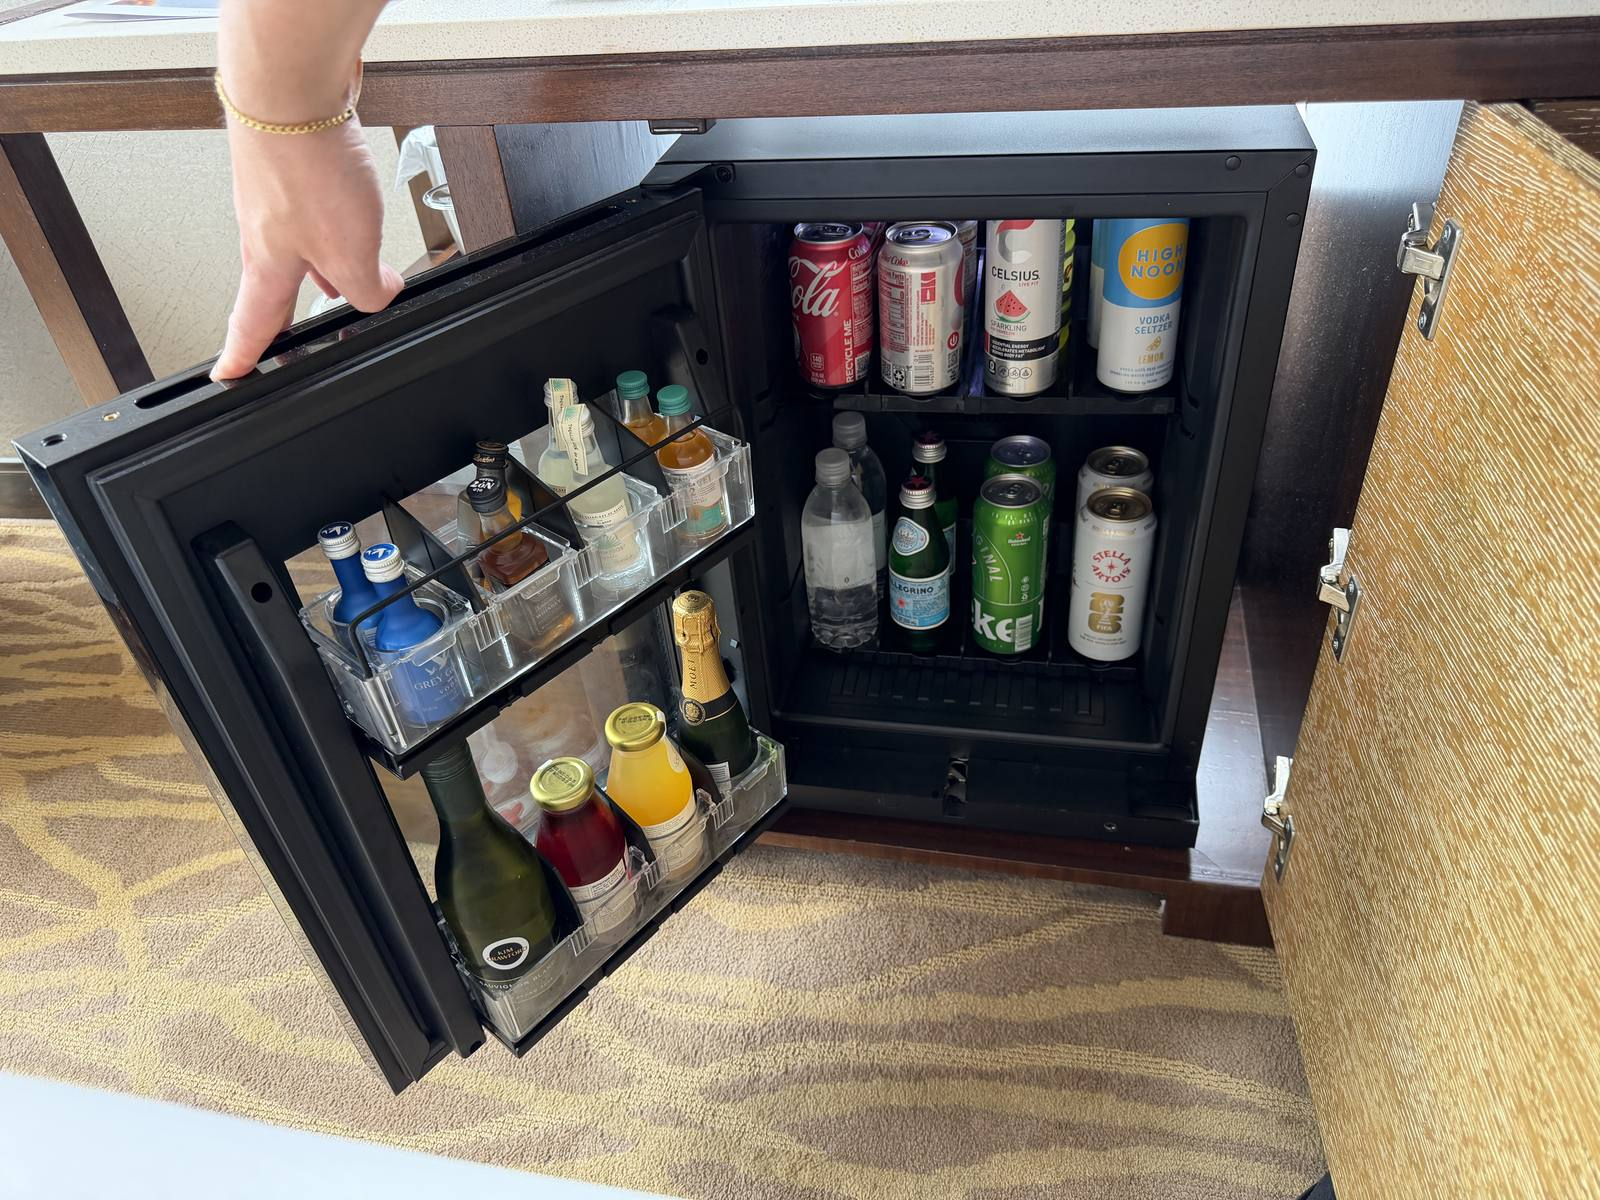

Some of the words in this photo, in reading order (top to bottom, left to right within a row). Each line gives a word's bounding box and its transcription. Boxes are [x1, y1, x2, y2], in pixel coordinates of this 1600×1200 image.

[1137, 244, 1185, 262] HIGH
[991, 266, 1040, 281] CELSIUS
[1130, 259, 1185, 279] NOON
[789, 256, 847, 318] ola
[990, 318, 1027, 333] SPARKLING
[1138, 312, 1171, 325] VODKA
[843, 319, 852, 336] ME
[1134, 320, 1173, 335] SELTZER
[844, 336, 855, 383] RECYCLE
[1138, 352, 1165, 365] LEMON
[1092, 549, 1132, 565] STELLA
[1090, 565, 1131, 584] ARTOIS
[1096, 624, 1113, 632] FIFA
[414, 675, 443, 690] GREY
[486, 946, 528, 962] CRAWFORD
[497, 946, 515, 956] KIM
